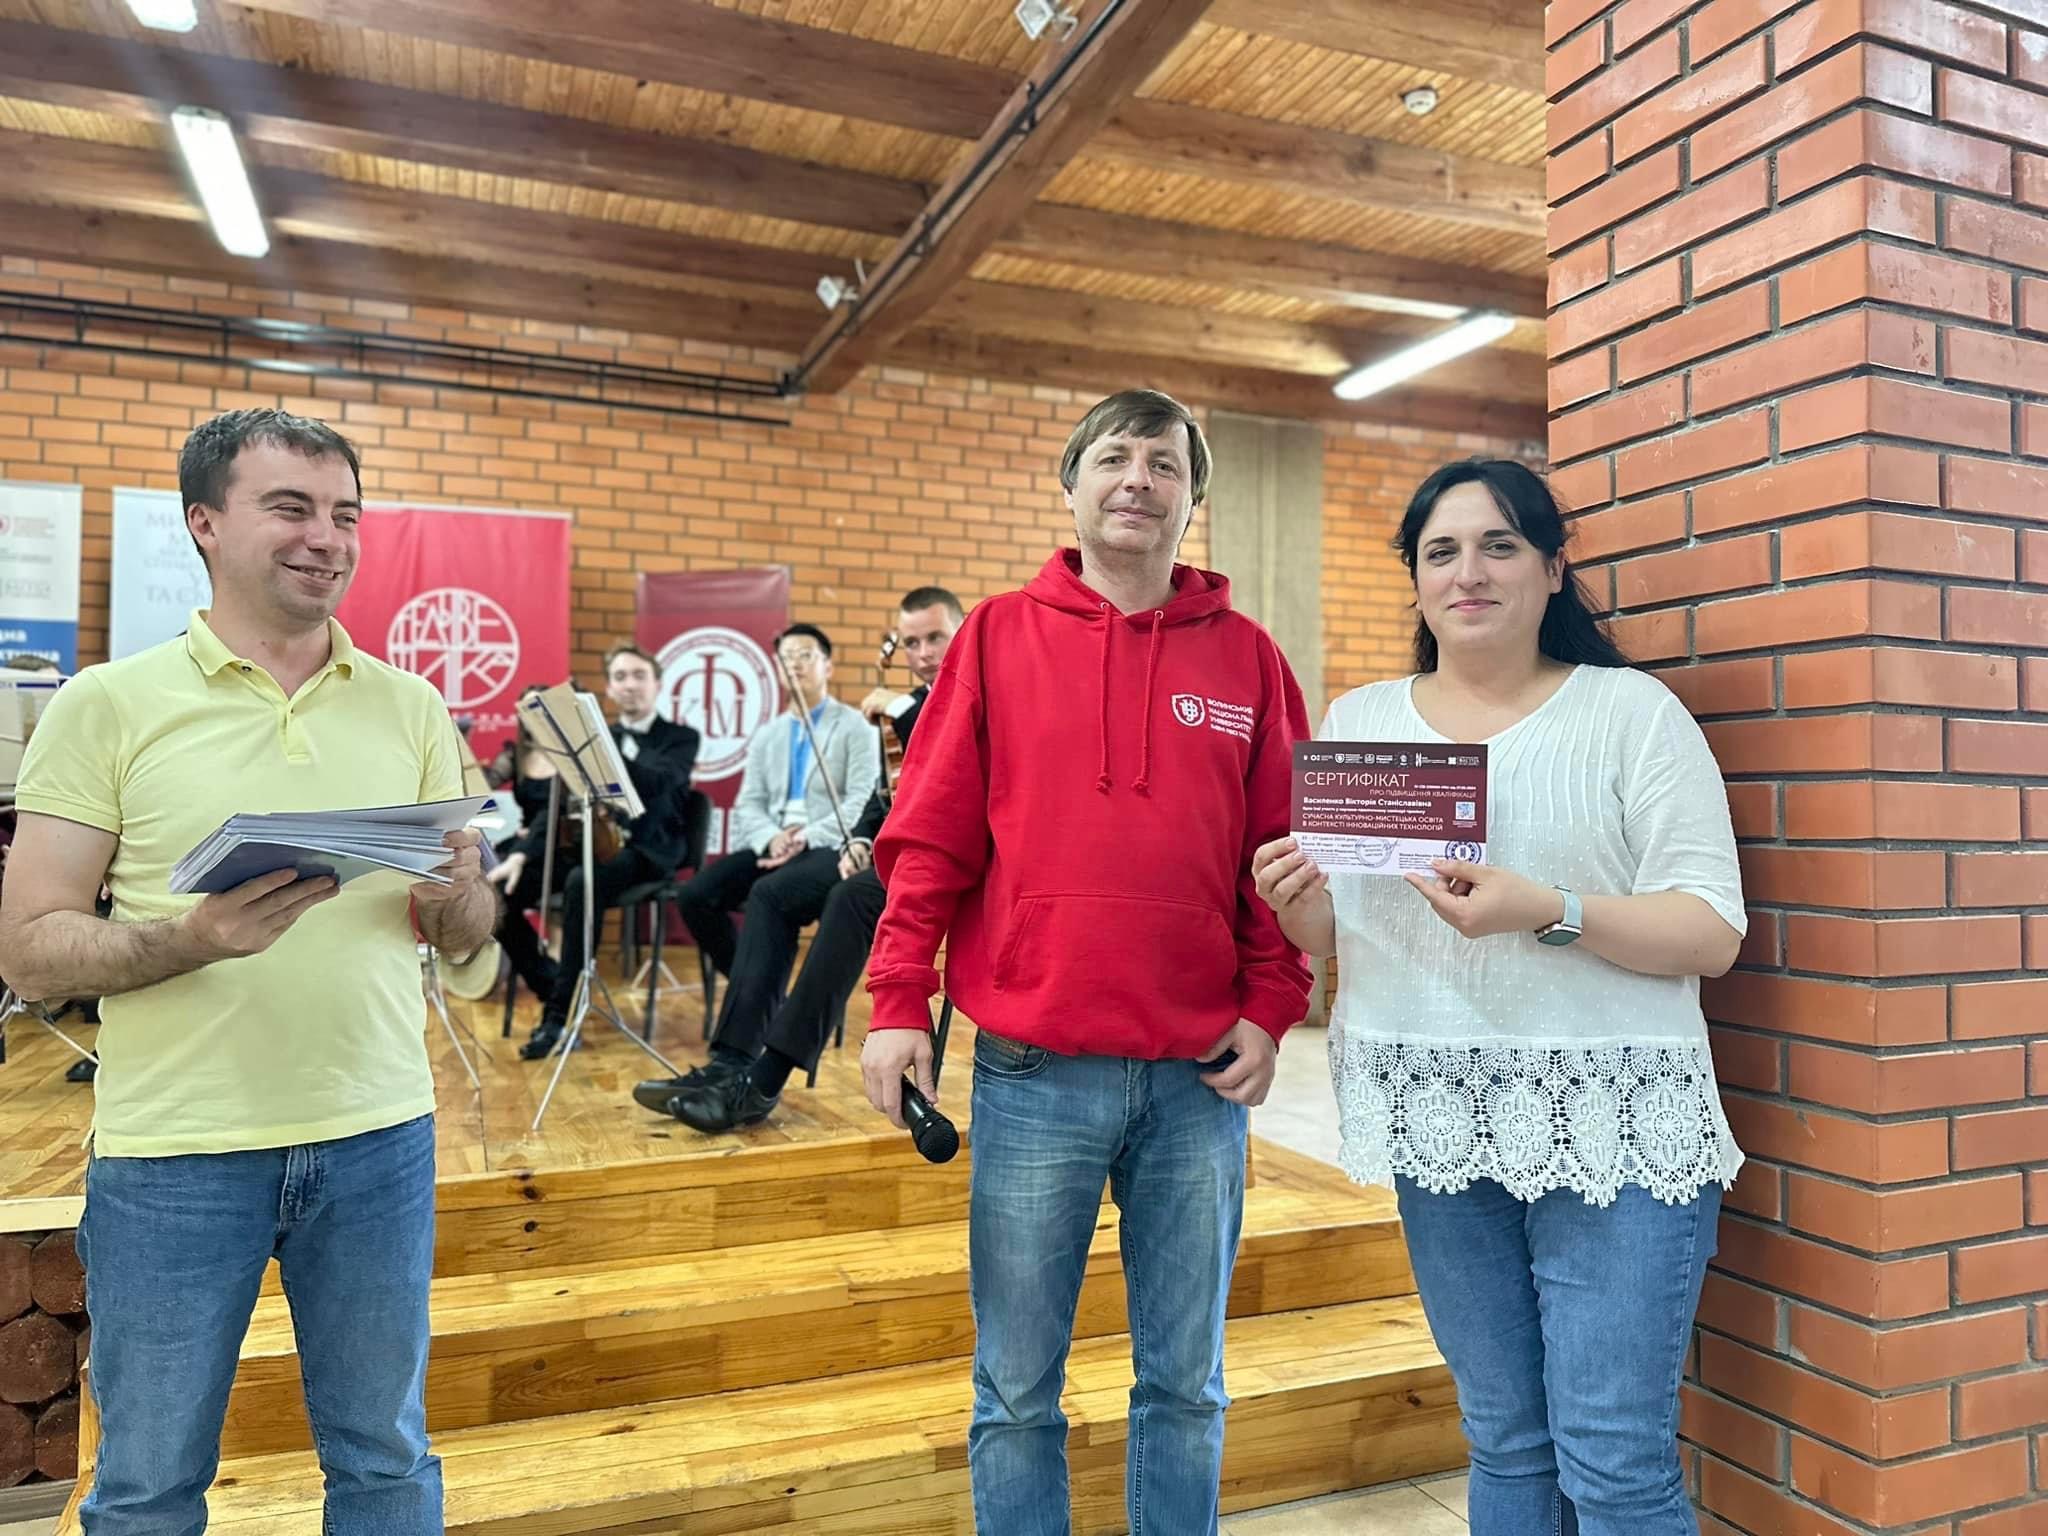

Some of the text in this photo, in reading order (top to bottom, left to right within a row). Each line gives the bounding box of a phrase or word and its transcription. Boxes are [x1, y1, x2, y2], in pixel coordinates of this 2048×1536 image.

[1304, 771, 1410, 788] СЕРТИФІКАТ
[1345, 798, 1377, 807] Вікторія
[1378, 799, 1432, 808] Станіславівна
[1419, 816, 1444, 824] ОСВІТА
[1308, 820, 1345, 828] КОНТЕКСТІ
[1400, 823, 1443, 831] ТЕХНОЛОГІЙ
